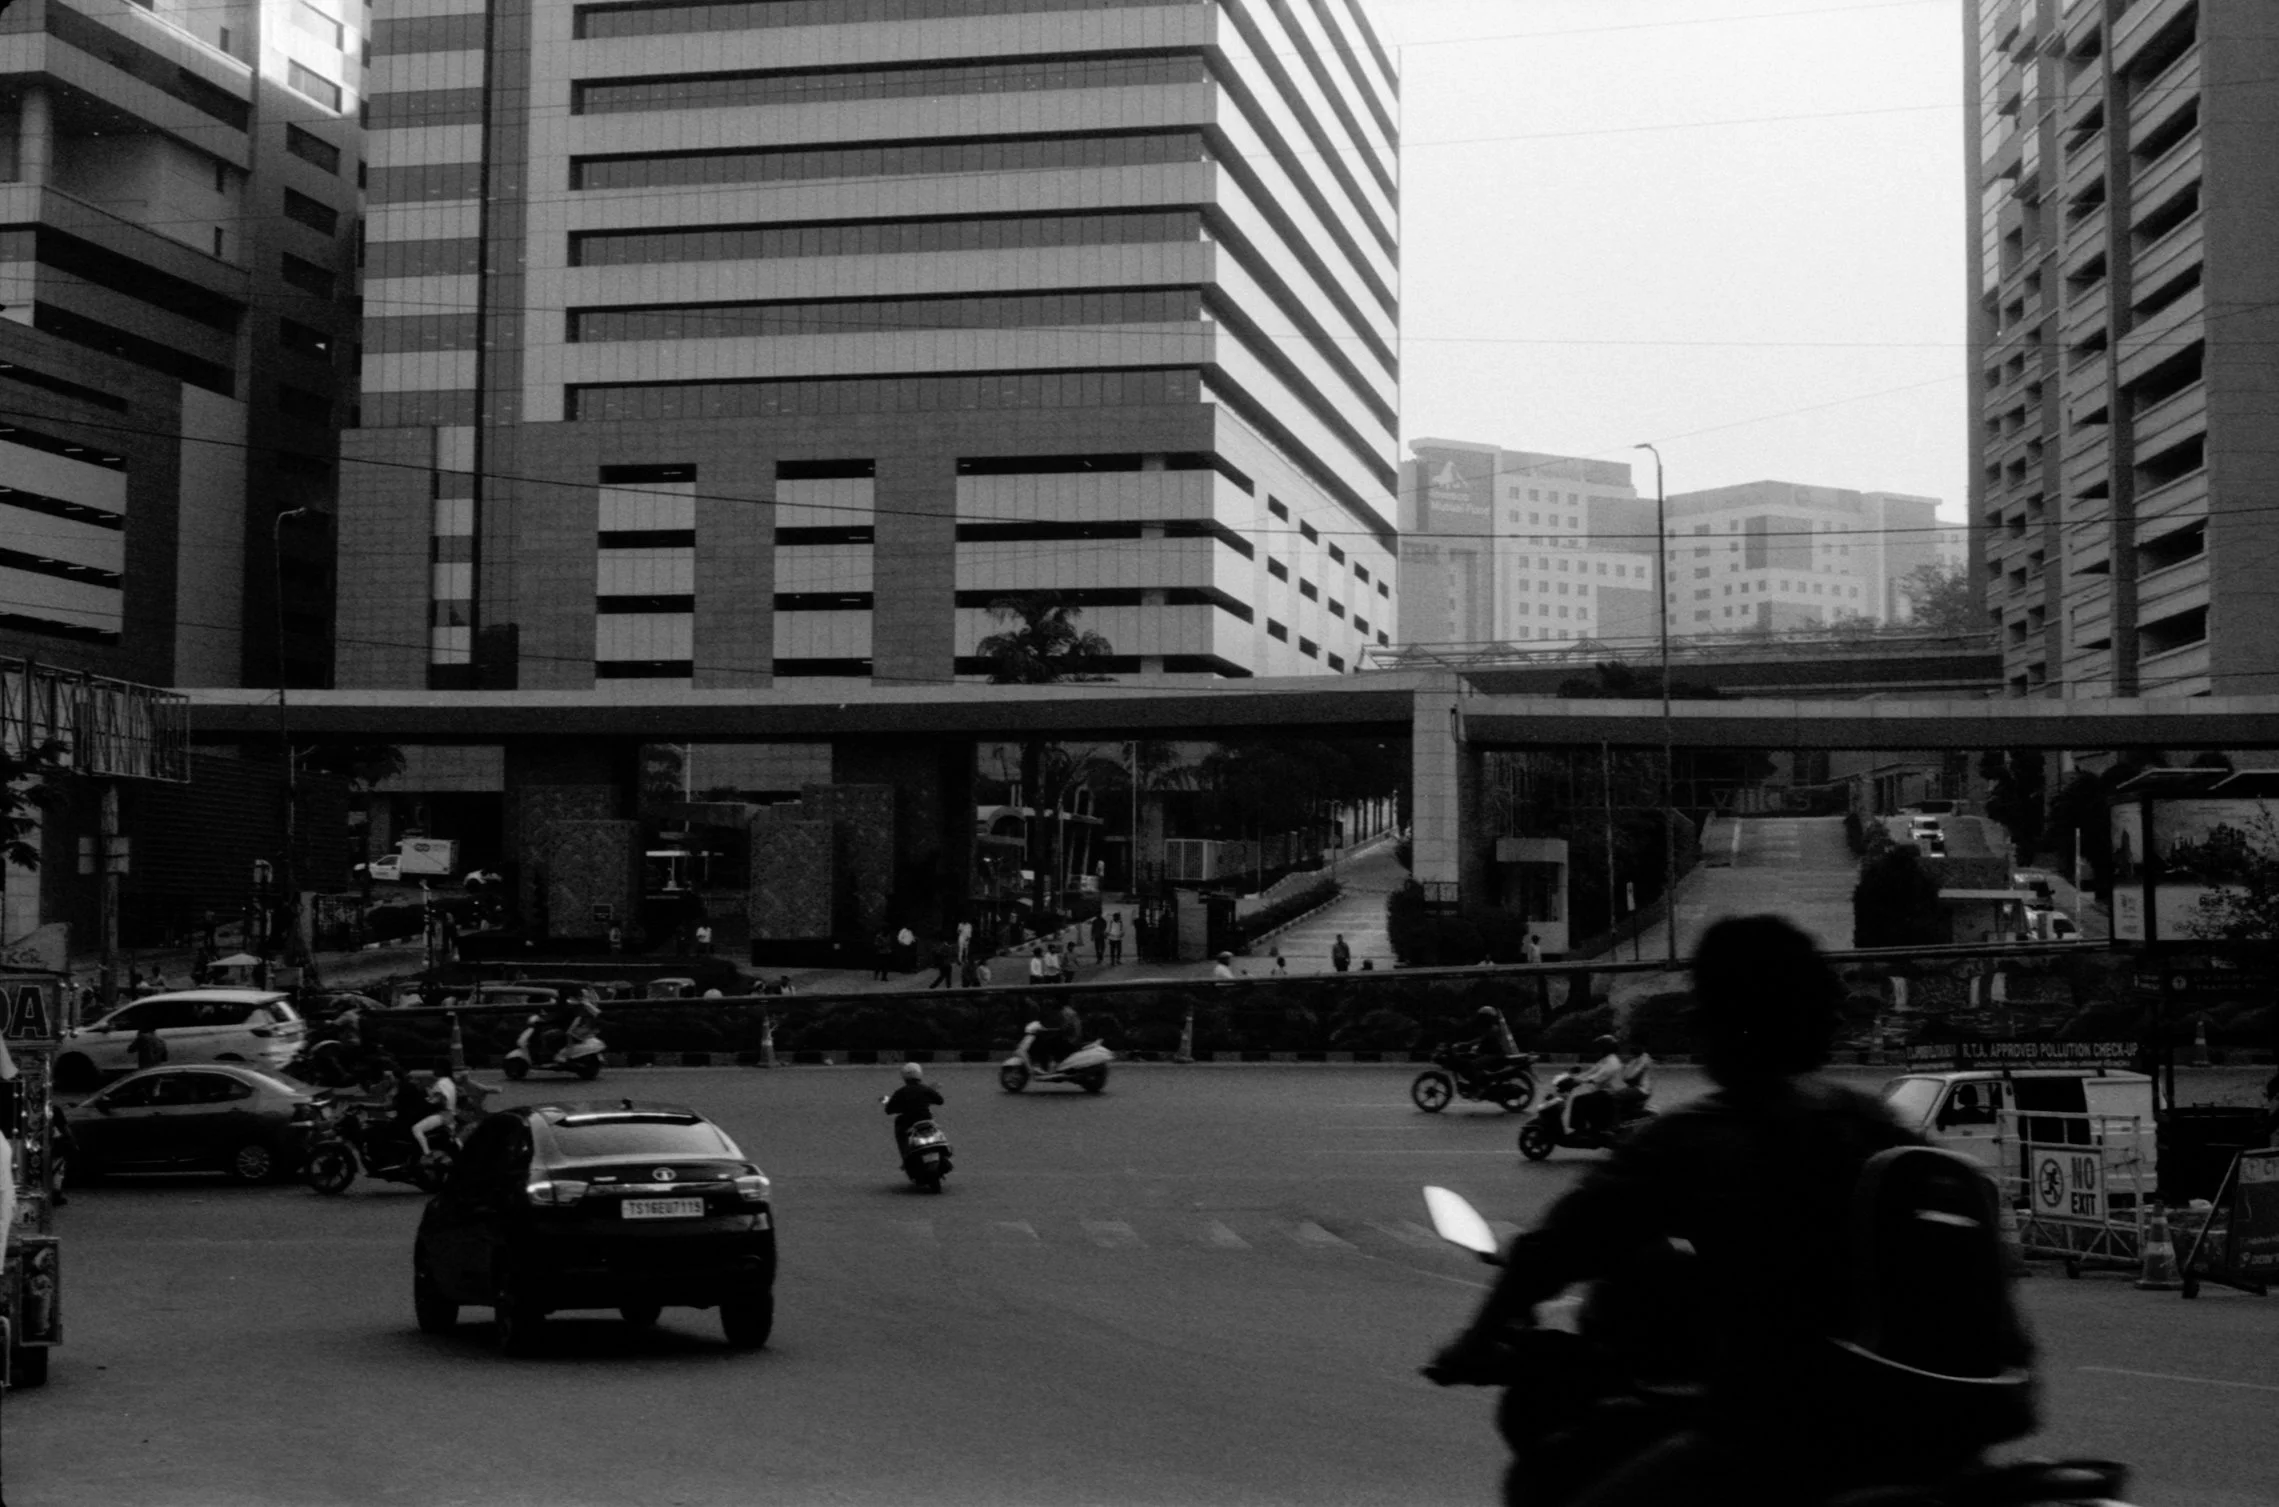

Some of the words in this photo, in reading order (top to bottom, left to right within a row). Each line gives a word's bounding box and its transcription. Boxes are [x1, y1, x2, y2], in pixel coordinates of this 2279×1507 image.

[0, 984, 51, 1038] A
[1990, 1042, 2038, 1058] APPROVED
[2040, 1042, 2090, 1058] POLLUTION
[2092, 1042, 2139, 1057] CHECK-UP
[2071, 1156, 2096, 1190] NO
[2070, 1191, 2097, 1216] EXIT
